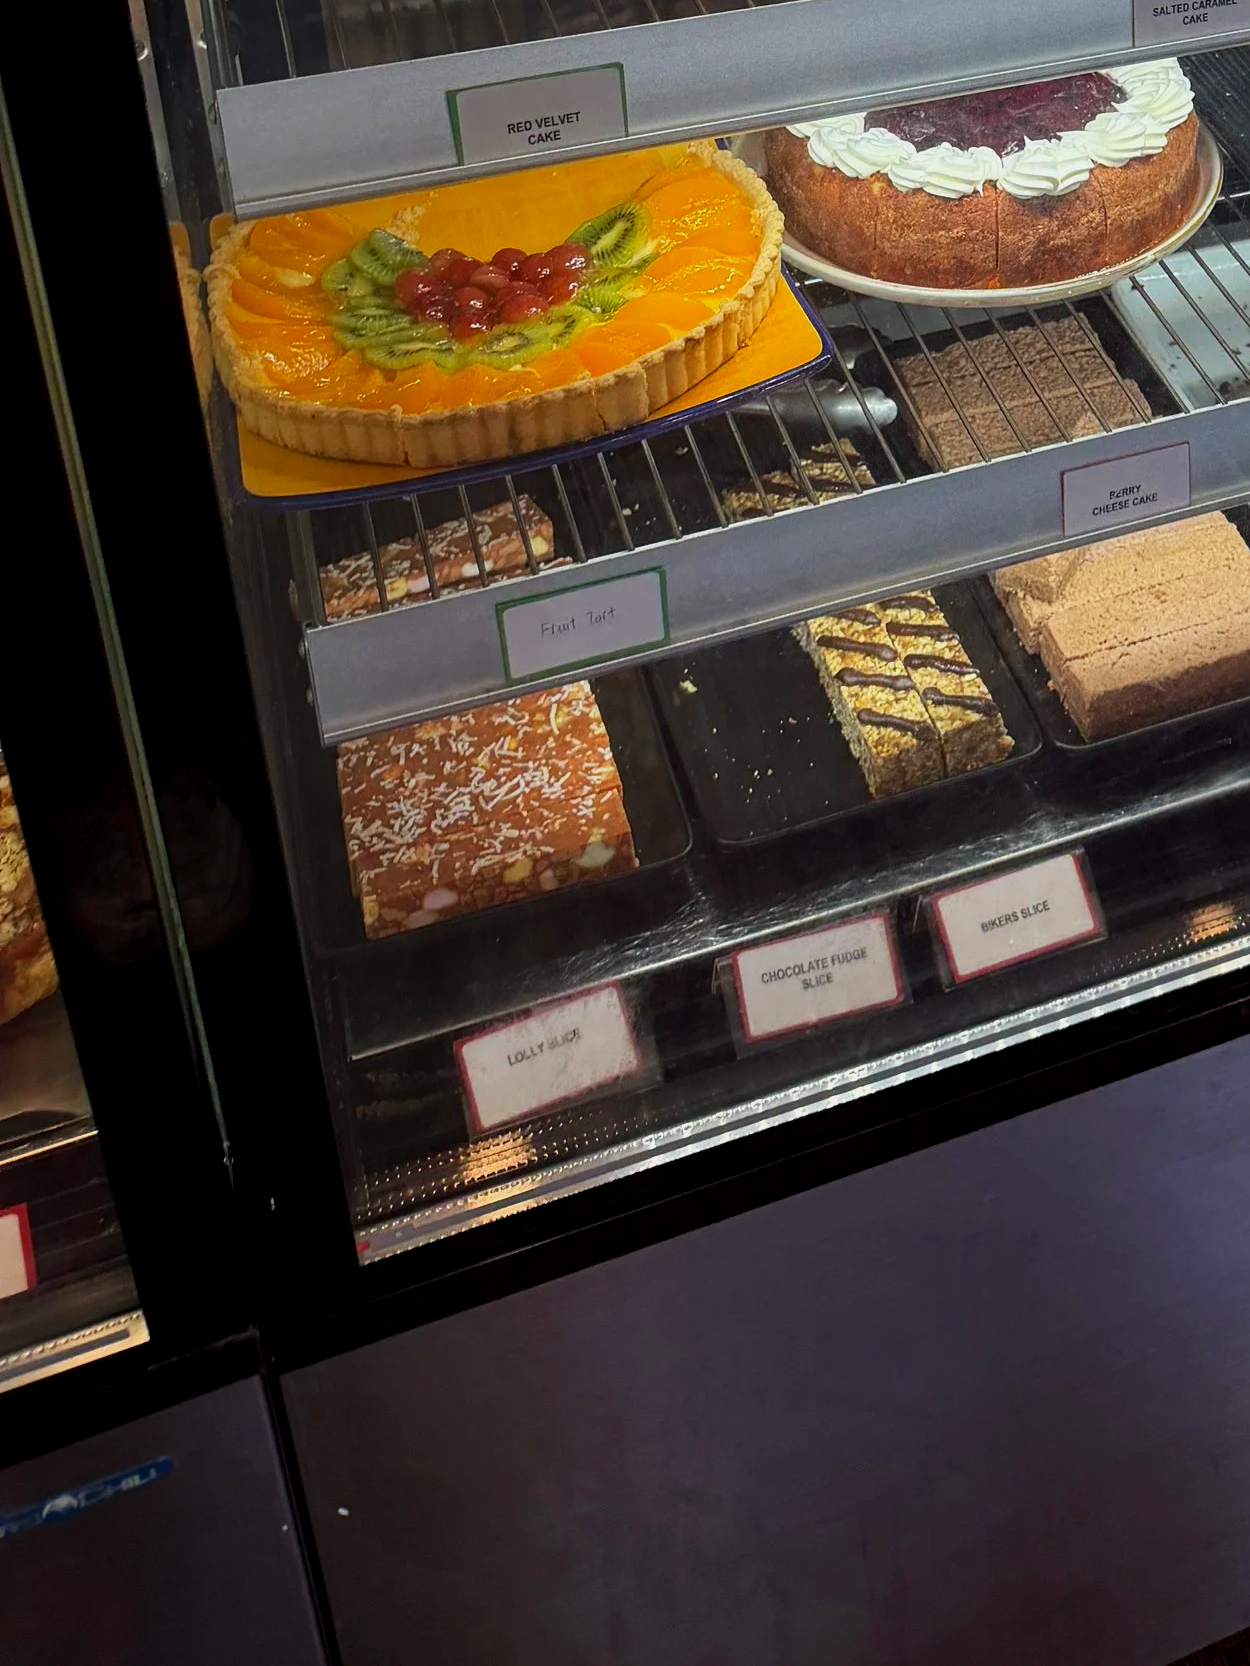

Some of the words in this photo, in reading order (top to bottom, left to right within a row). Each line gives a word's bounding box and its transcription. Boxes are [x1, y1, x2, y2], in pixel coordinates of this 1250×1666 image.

[1152, 2, 1190, 18] SALTED
[1182, 12, 1209, 26] CAKE
[507, 118, 533, 135] RED
[534, 111, 581, 129] VELVET
[527, 129, 562, 146] CAKE
[1092, 501, 1131, 517] CHEESE
[1132, 492, 1158, 508] CAKE
[541, 617, 576, 638] Fruit
[980, 910, 1020, 934] BIKERS
[1020, 899, 1051, 919] SLICE
[760, 956, 829, 985] CHOCOLATE
[831, 946, 868, 967] FUDGE
[802, 972, 834, 991] SLICE
[507, 1040, 544, 1067] LOLLY
